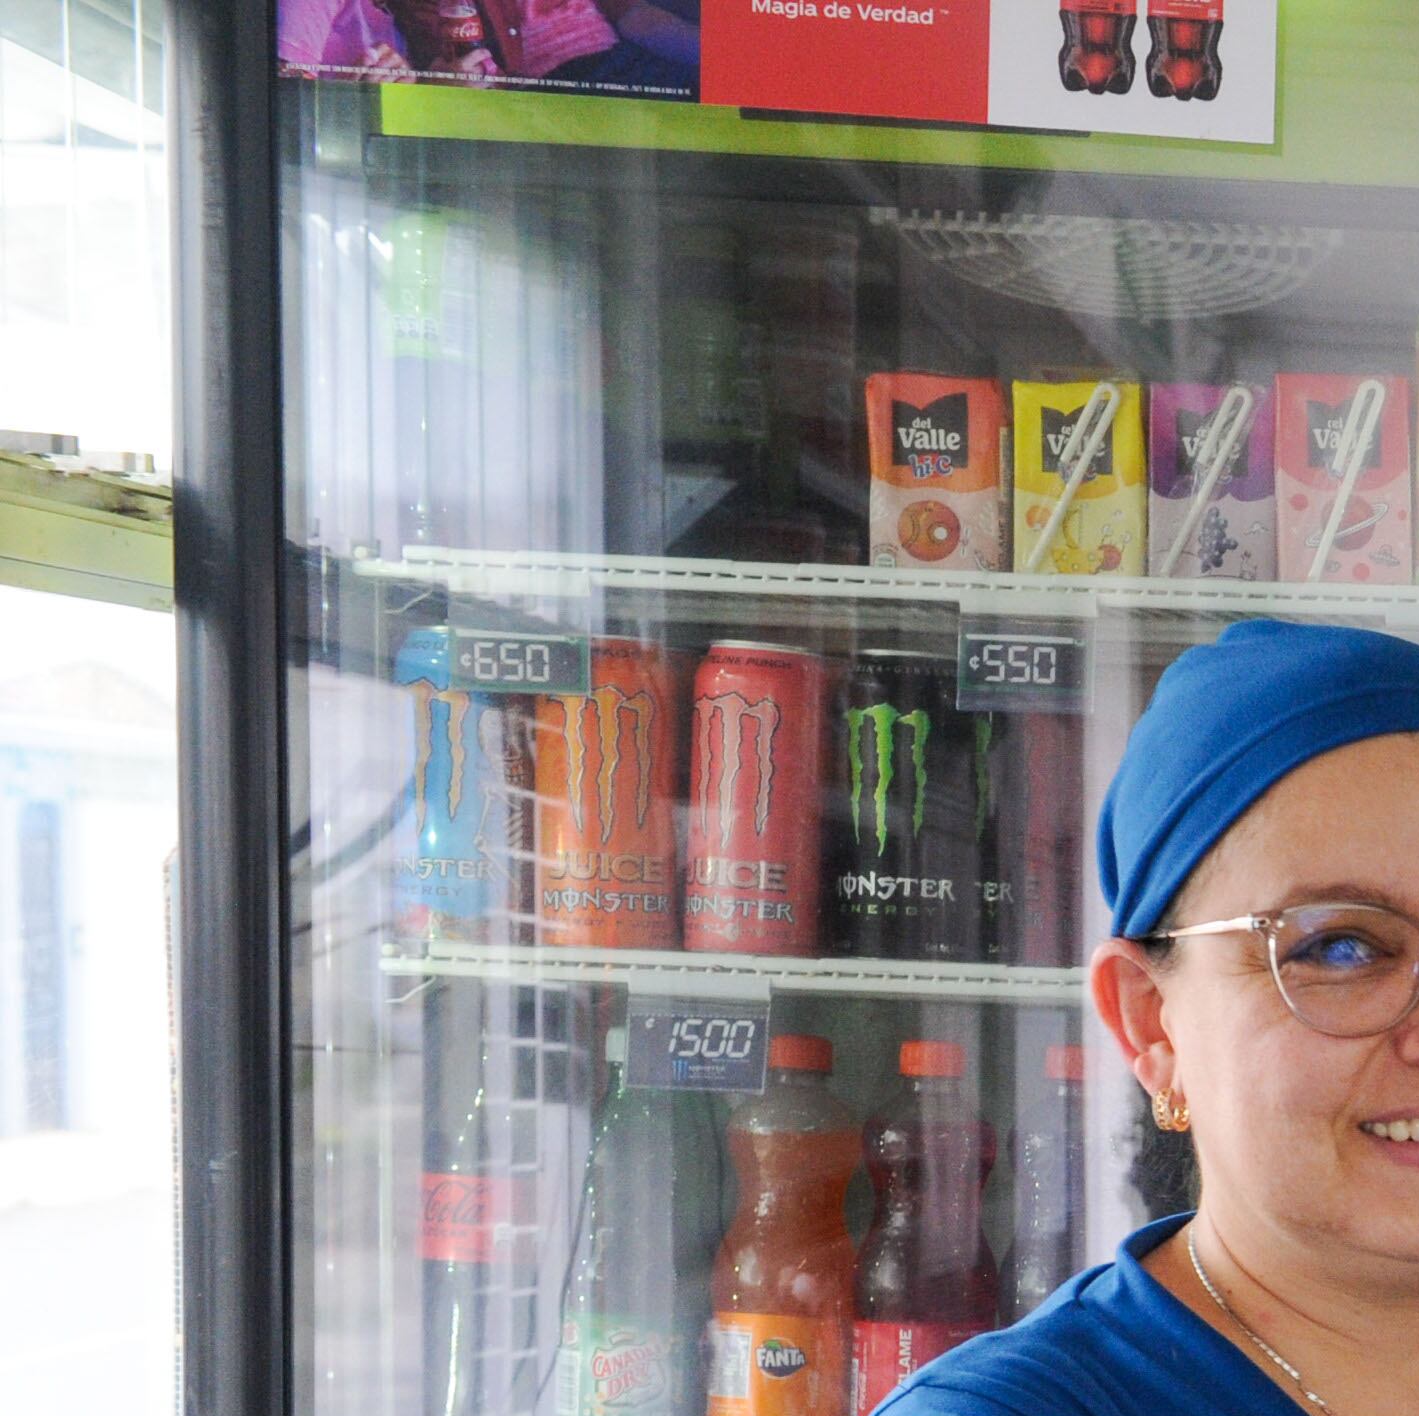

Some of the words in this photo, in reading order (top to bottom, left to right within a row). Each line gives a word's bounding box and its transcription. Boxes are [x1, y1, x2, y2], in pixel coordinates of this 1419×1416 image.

[751, 0, 817, 18] Magia
[823, 3, 851, 20] de
[856, 4, 934, 25] Verdad
[912, 416, 931, 429] del
[898, 426, 961, 451] Valle
[460, 642, 549, 682] ¢650
[969, 645, 1057, 685] ¢550
[400, 858, 494, 880] NSTER
[549, 852, 668, 881] JUICE
[669, 1019, 755, 1057] 1500
